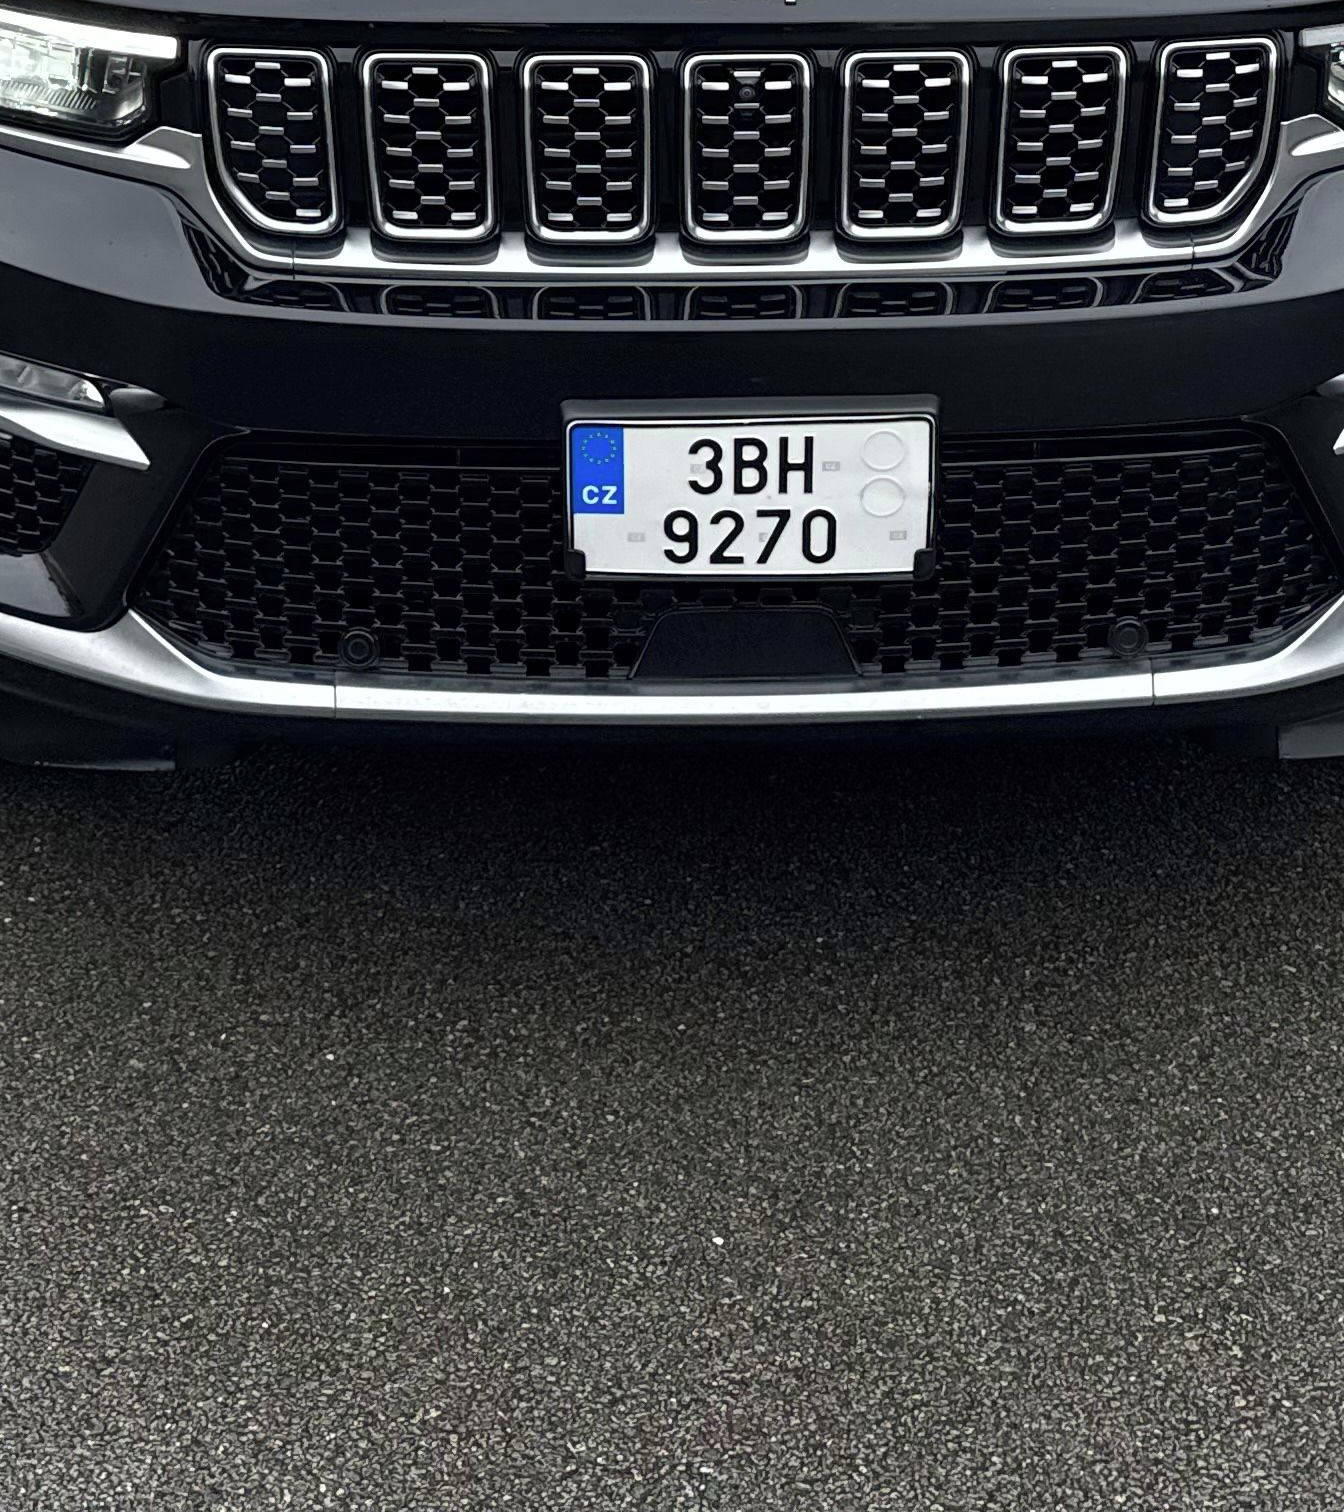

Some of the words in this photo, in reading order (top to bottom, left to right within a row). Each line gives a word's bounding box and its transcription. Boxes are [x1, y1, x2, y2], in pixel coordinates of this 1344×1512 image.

[688, 435, 814, 495] 3BH
[582, 484, 618, 505] CZ
[663, 508, 837, 565] 9270
